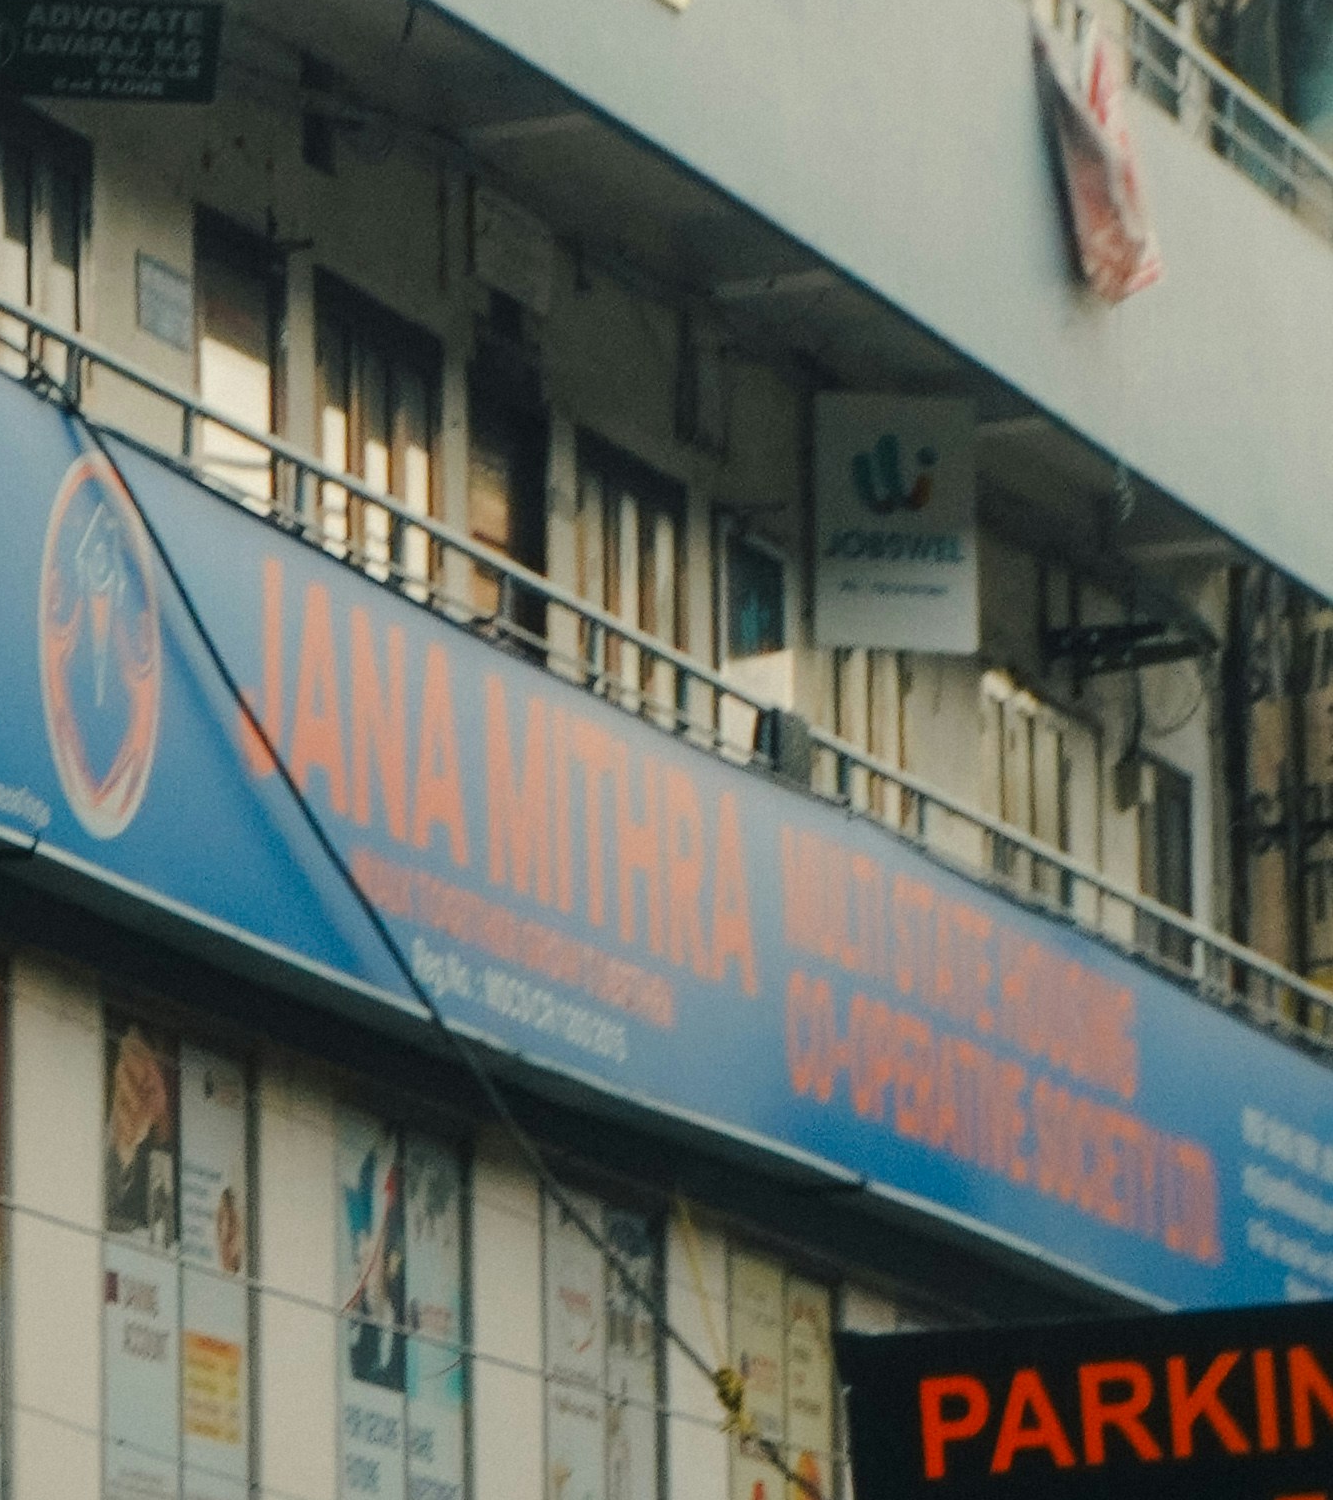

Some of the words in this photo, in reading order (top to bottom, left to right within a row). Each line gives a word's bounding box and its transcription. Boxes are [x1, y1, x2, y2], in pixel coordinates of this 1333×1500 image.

[24, 3, 203, 36] ADVOCATE
[237, 556, 469, 868] JANA
[485, 672, 759, 996] MITHRA
[918, 1342, 1333, 1481] PARKIN
